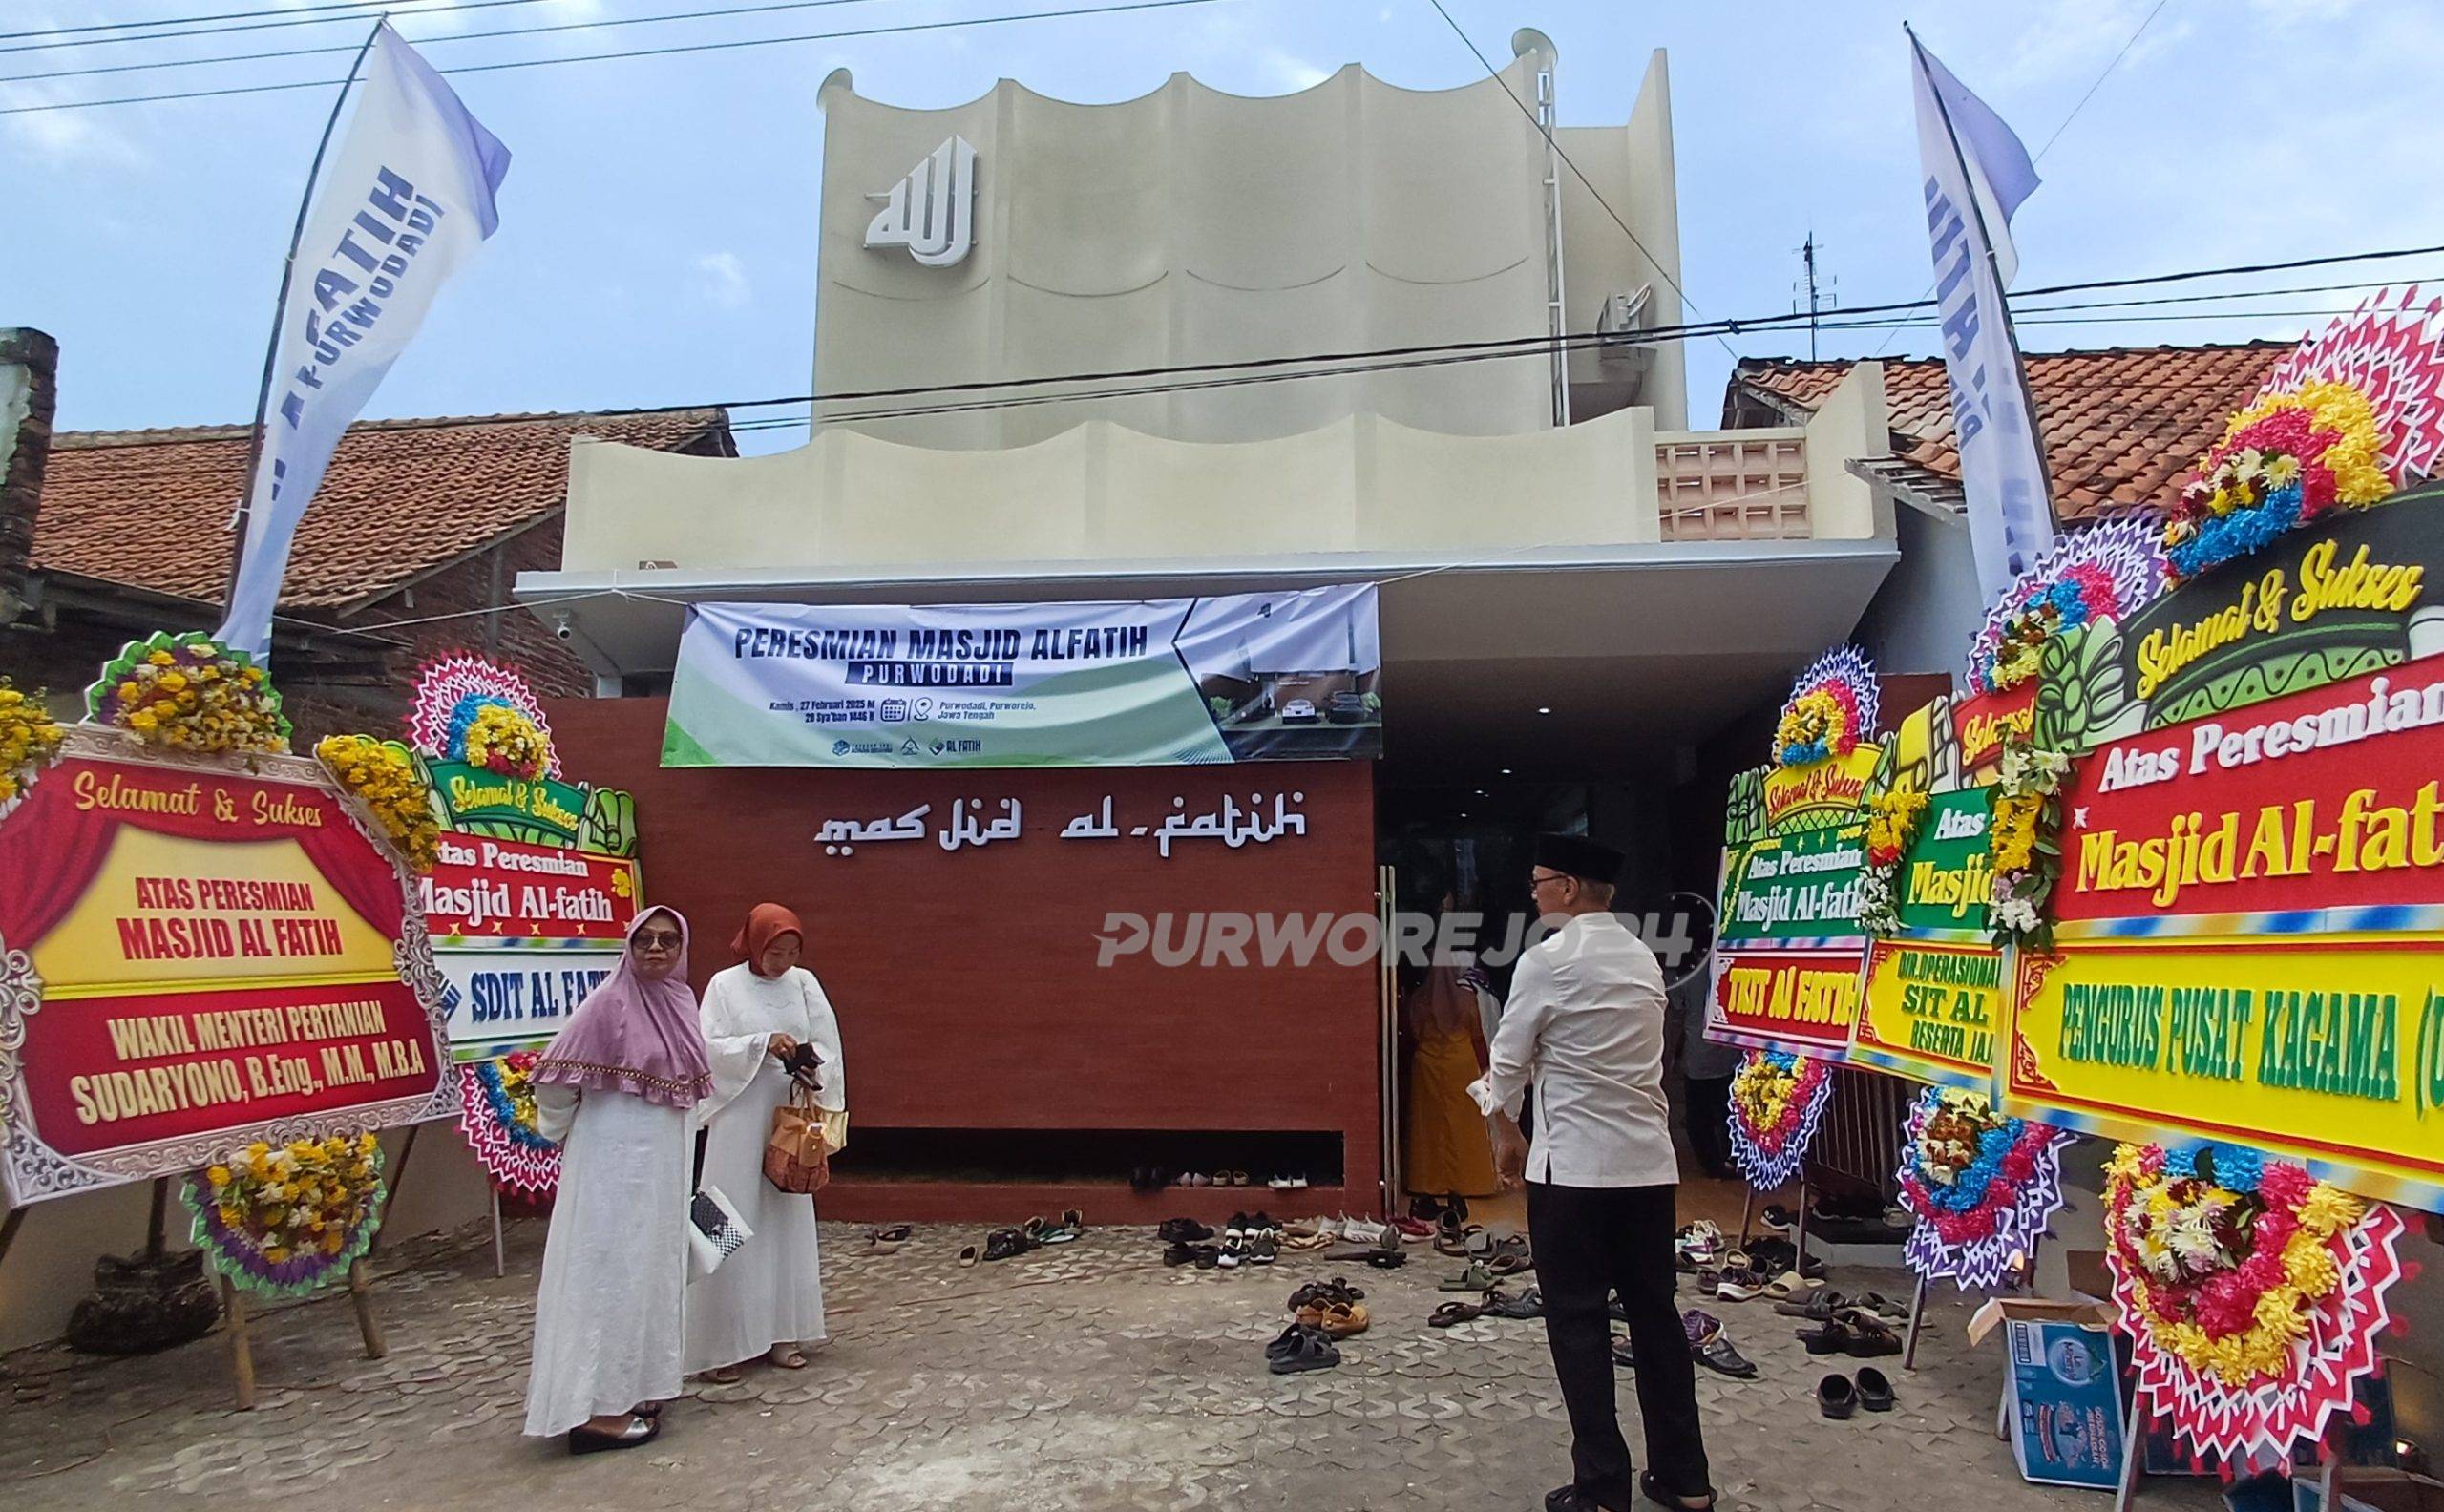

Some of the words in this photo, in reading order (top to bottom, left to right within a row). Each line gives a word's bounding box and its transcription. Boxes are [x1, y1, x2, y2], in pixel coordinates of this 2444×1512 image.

[2136, 581, 2255, 700] Selamat
[2253, 569, 2288, 633] &
[2291, 538, 2425, 622] Sukses
[735, 628, 897, 661] PERESMIAN
[907, 628, 1022, 661] MASJID
[1030, 625, 1148, 661] ALFATIH
[860, 665, 1003, 684] PURWODADI
[800, 701, 811, 711] 27
[811, 700, 844, 711] Februari
[845, 700, 866, 710] 2025
[938, 710, 962, 720] Jawa
[963, 710, 995, 721] Tengah
[939, 701, 988, 711] Purwodadi,
[959, 739, 981, 752] FATIH
[2098, 746, 2180, 794] Atas
[2188, 677, 2444, 776] Peresmian
[74, 770, 201, 815] Selamat
[214, 788, 239, 822] &
[252, 790, 323, 827] Sukses
[450, 775, 513, 812] Selamat
[532, 786, 579, 830] Sukses
[1934, 808, 1987, 840] Atas
[437, 841, 477, 866] tas
[481, 842, 589, 877] Peresmian
[1748, 856, 1778, 879] Atas
[1779, 843, 1862, 876] Peresmian
[2075, 812, 2240, 908] Masjid
[135, 877, 195, 910] ATAS
[197, 878, 315, 912] PERESMIAN
[518, 883, 614, 922] Al-fatih
[1737, 885, 1793, 932] Masjid
[116, 917, 235, 960] MASJID
[238, 918, 273, 957] AL
[272, 918, 344, 956] FATIH
[471, 972, 524, 1022] SDIT
[530, 970, 558, 1017] AL
[1794, 970, 1860, 1028] FATIH
[1901, 984, 1948, 1018] SIT
[1949, 991, 1989, 1027] AL
[106, 1014, 196, 1060] WAKIL
[193, 1007, 288, 1051] MENTERI
[285, 1000, 387, 1042] PERTANIAN
[1910, 1019, 1965, 1058] BESERTA
[2058, 983, 2163, 1070] PENGURUS
[2166, 986, 2253, 1081] PUSAT
[2257, 989, 2400, 1101] KAGAMA
[70, 1058, 250, 1125] SUDARYONO,
[245, 1053, 324, 1097] B.Eng.,
[320, 1044, 376, 1086] M.M.,
[371, 1038, 426, 1080] M.B.A
